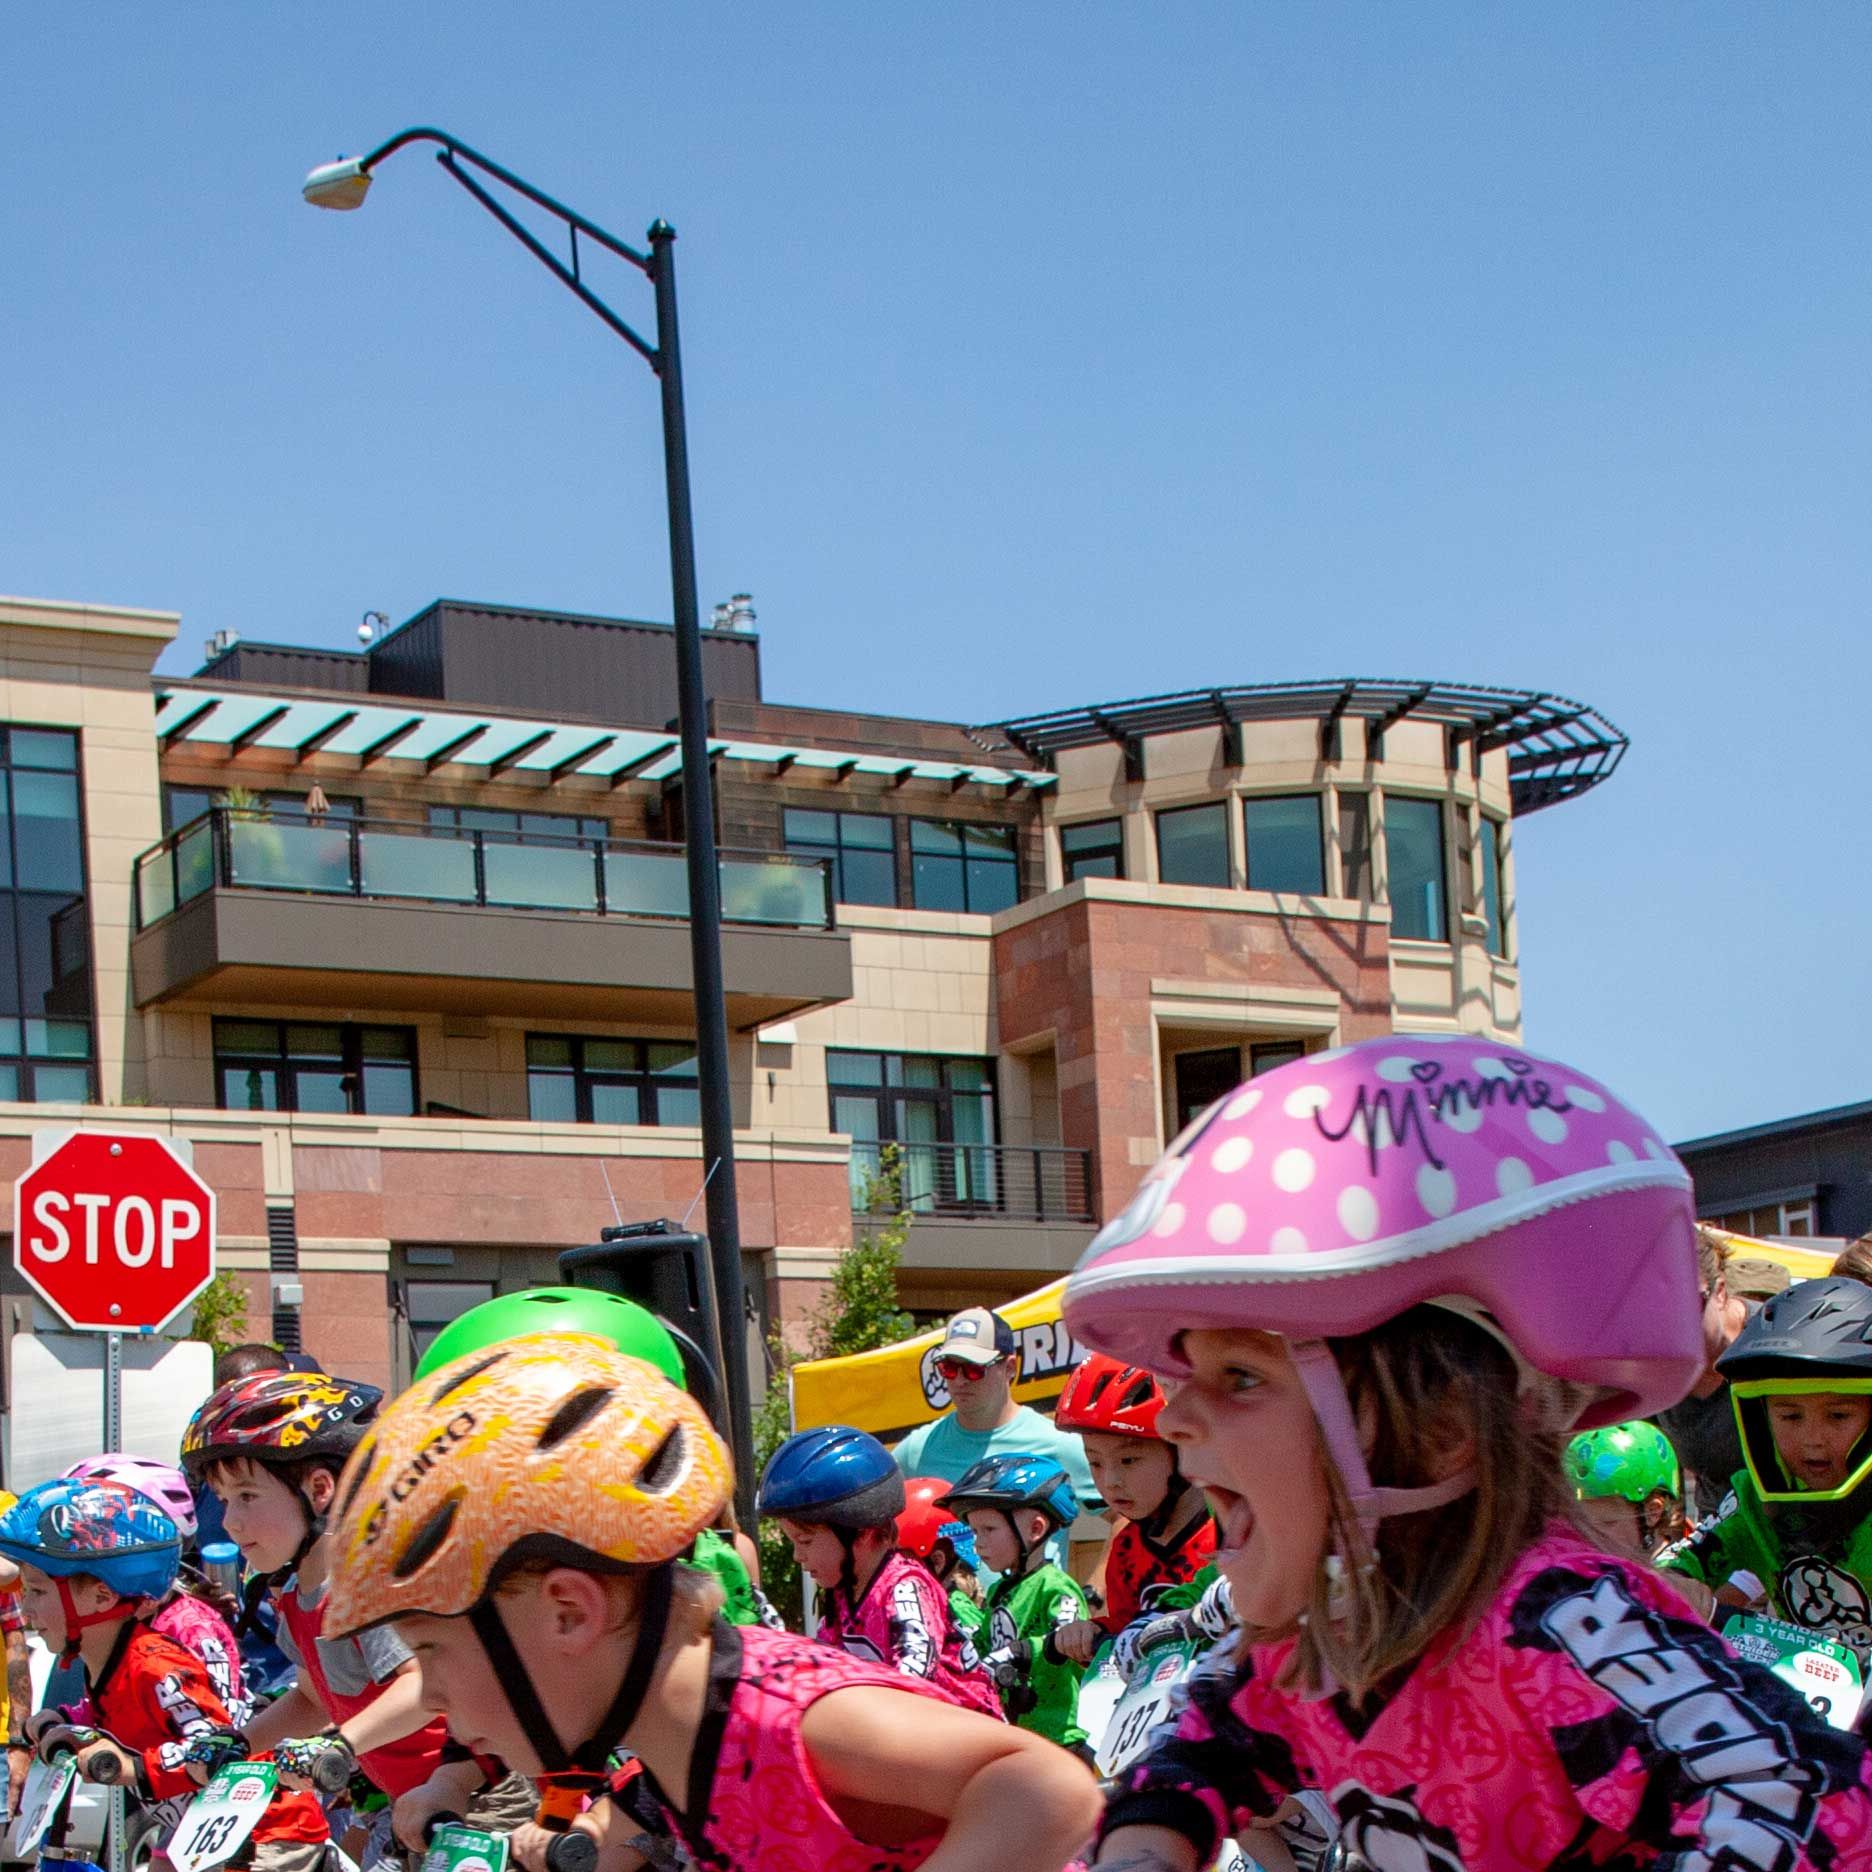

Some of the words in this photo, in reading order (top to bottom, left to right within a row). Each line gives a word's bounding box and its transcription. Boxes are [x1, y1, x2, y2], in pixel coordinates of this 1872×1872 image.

[1315, 1057, 1573, 1177] Minnie
[30, 1190, 200, 1270] STOP
[392, 1411, 476, 1501] GIRO
[1754, 1623, 1765, 1634] 3
[1767, 1626, 1805, 1646] YEAR
[1807, 1639, 1835, 1657] OLD
[1804, 1665, 1840, 1683] BEEF
[1111, 1700, 1161, 1758] 137
[183, 1814, 239, 1857] 163
